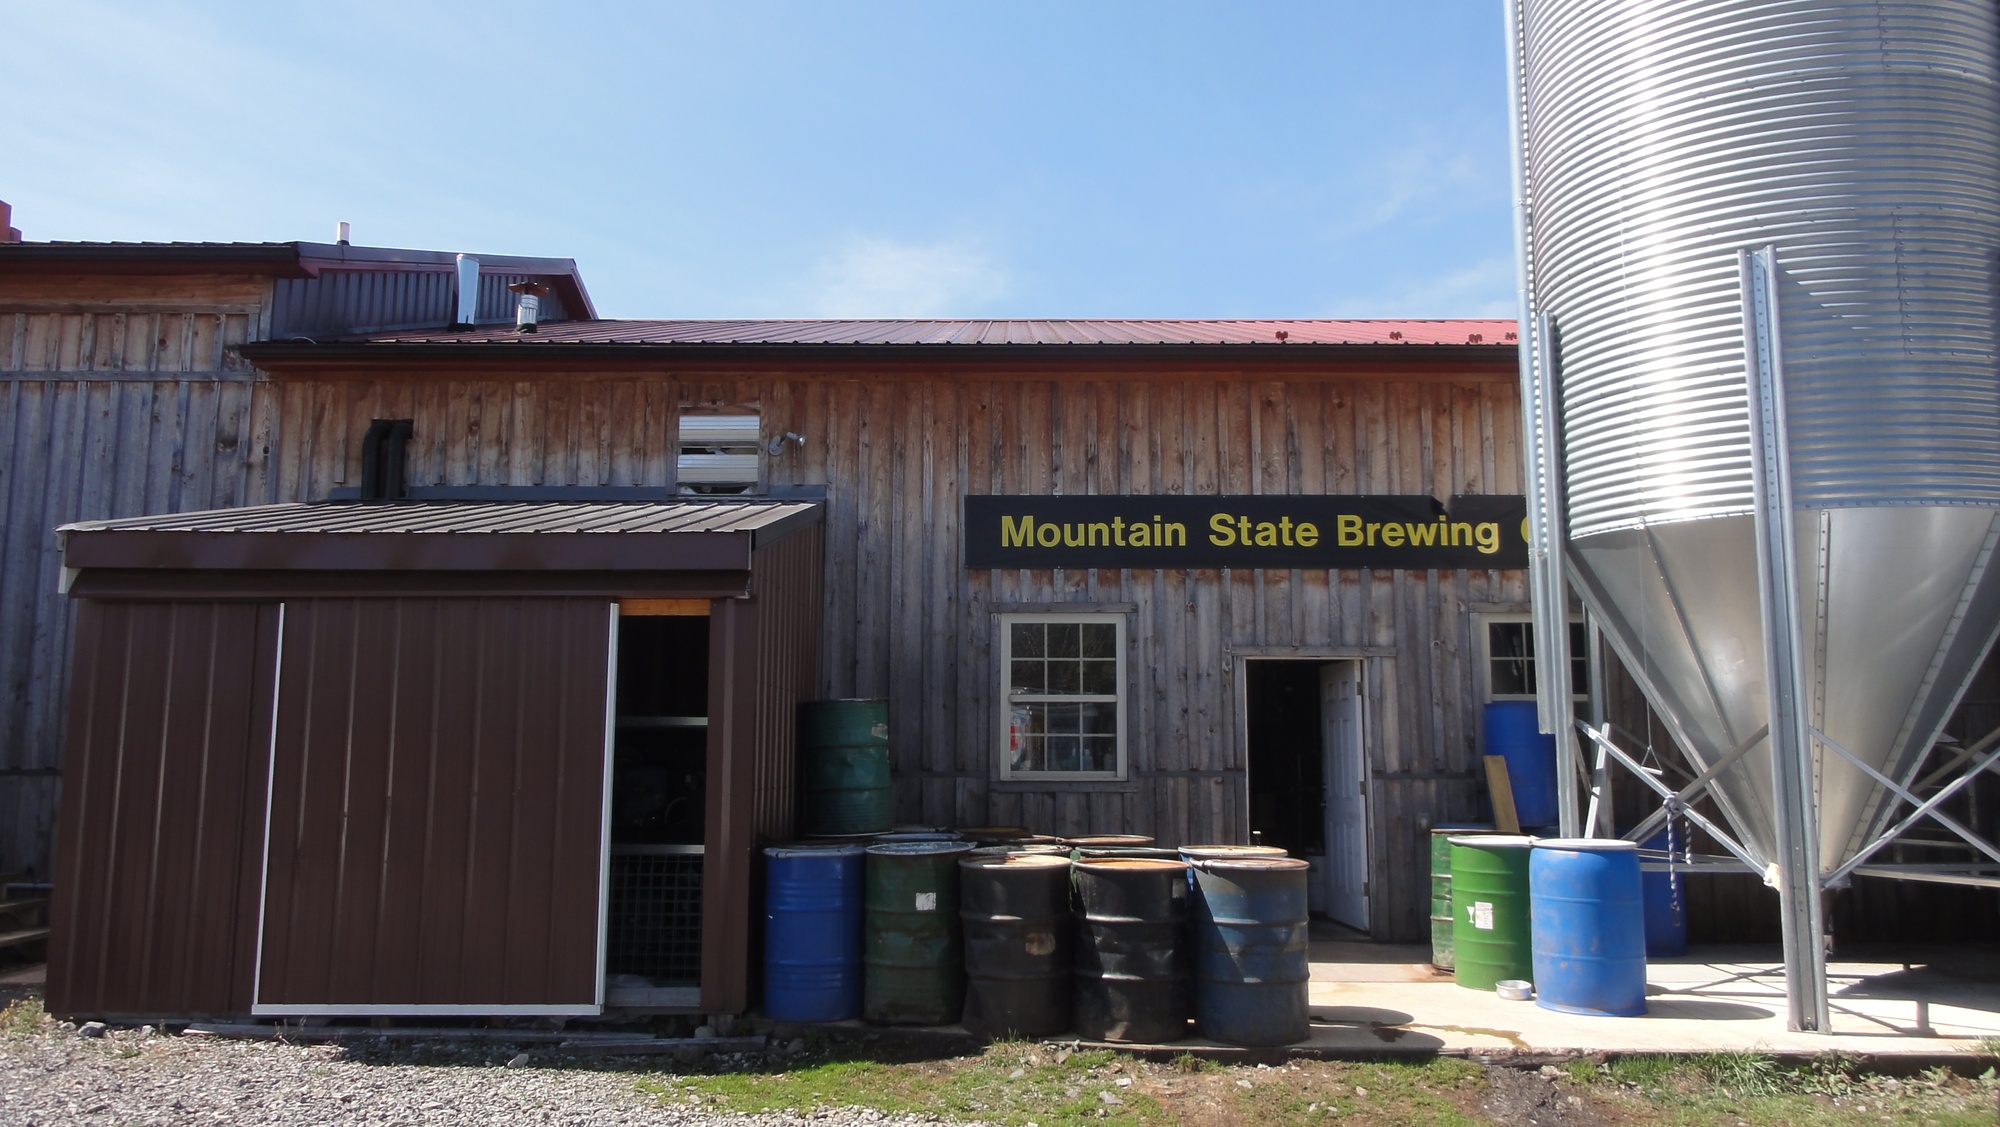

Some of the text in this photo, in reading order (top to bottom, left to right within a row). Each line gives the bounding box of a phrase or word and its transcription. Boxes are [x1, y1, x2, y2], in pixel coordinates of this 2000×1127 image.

[1001, 515, 1186, 547] Mountain
[1208, 513, 1319, 547] State
[1337, 514, 1499, 554] Brewing
